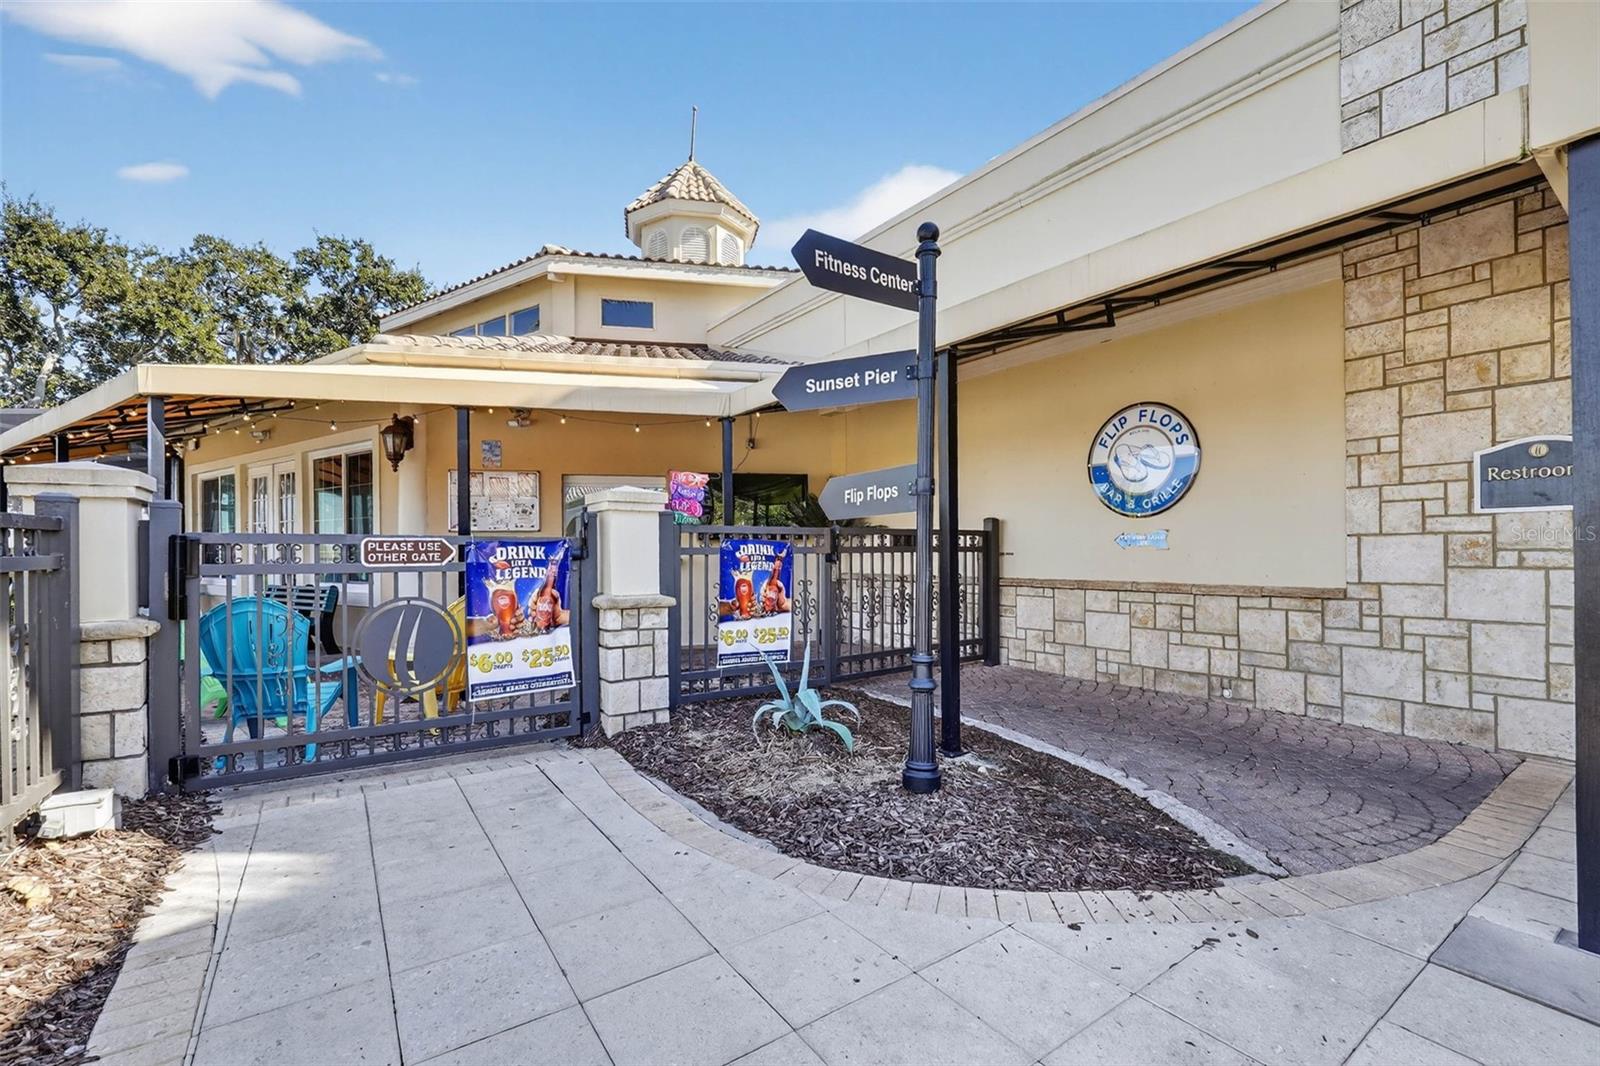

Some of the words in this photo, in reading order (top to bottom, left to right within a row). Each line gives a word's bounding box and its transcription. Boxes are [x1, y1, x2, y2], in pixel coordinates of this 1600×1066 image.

[814, 249, 867, 280] Fitness
[869, 267, 914, 293] Center
[805, 373, 860, 393] Sunset
[864, 368, 898, 386] Pier
[1098, 415, 1128, 449] FLIP
[1139, 409, 1190, 446] FLOPS
[844, 488, 864, 505] Flip
[867, 485, 898, 502] Flops
[1100, 483, 1123, 505] BAR
[368, 542, 414, 551] PLEASE
[418, 542, 441, 551] USE
[495, 545, 546, 561] DRINK
[368, 553, 407, 562] OTHER
[411, 553, 441, 561] GATE
[496, 566, 547, 581] LEGEND
